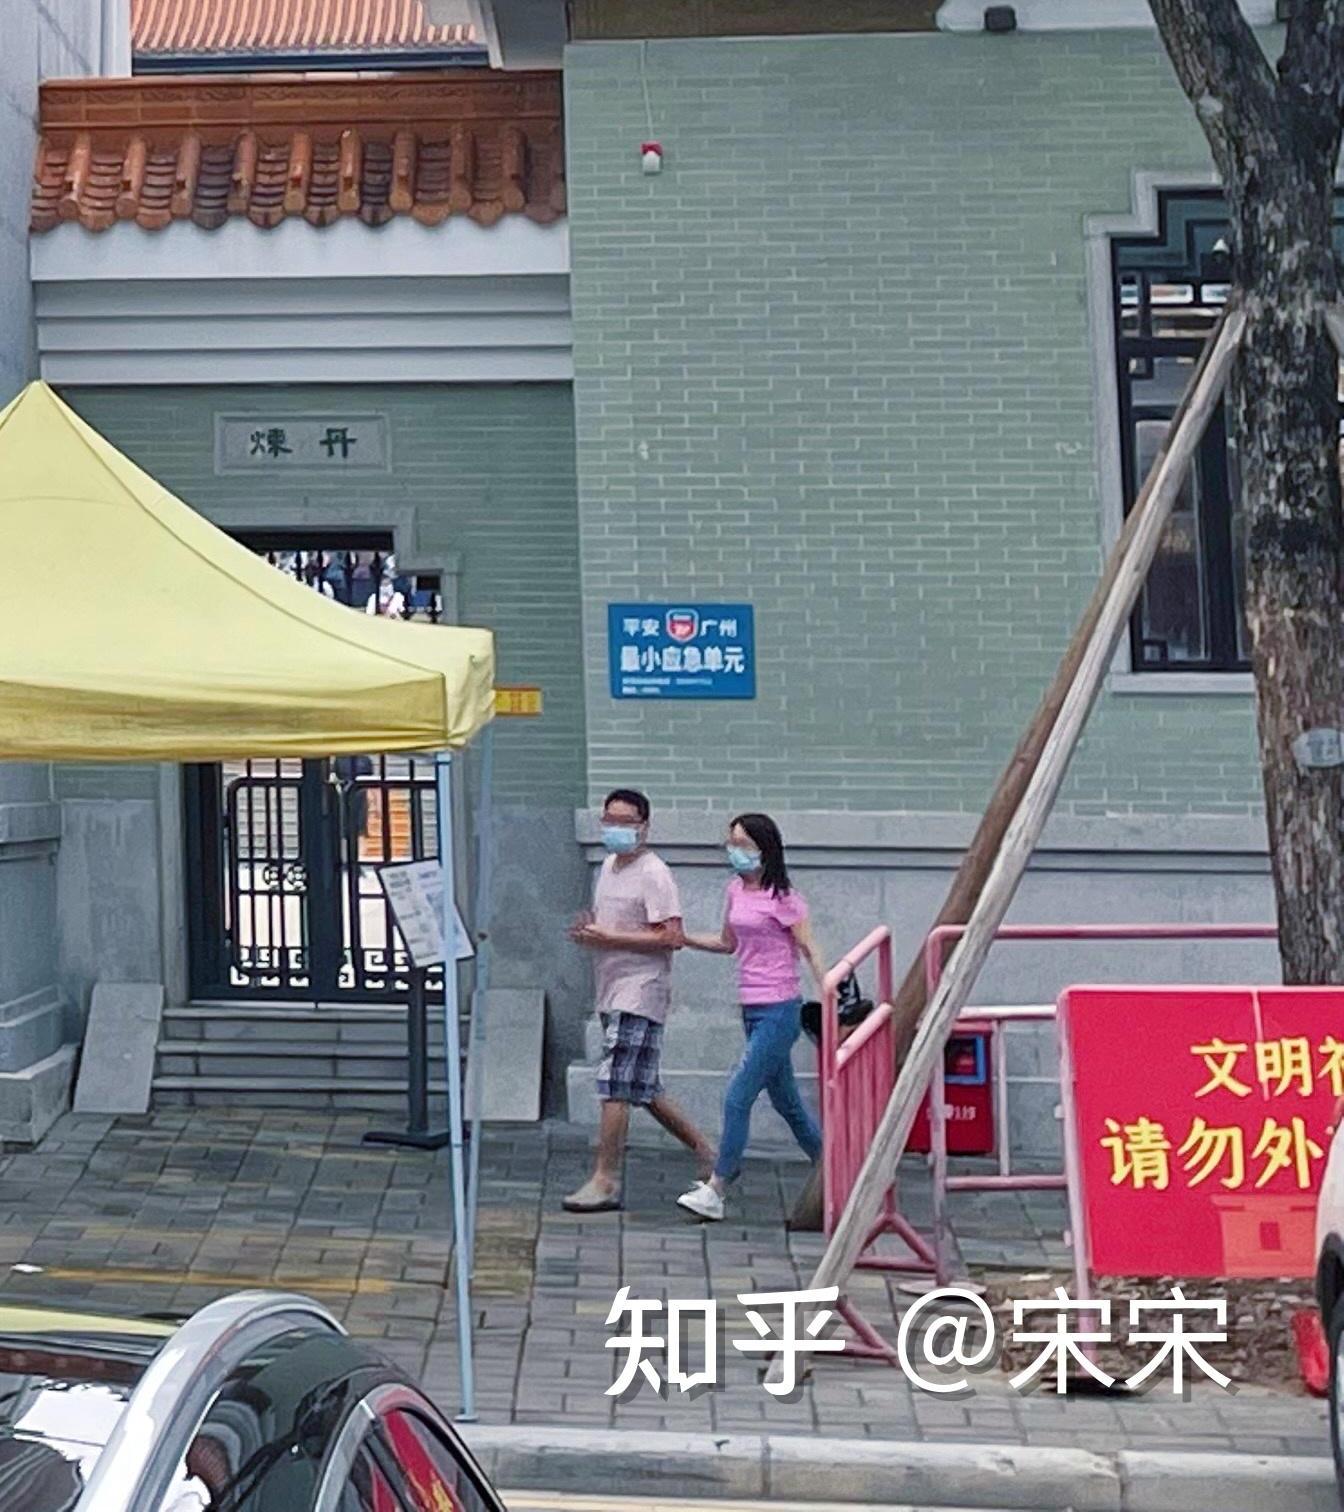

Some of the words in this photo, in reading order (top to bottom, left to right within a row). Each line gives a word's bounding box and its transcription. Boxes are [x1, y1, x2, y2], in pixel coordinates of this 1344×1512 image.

[622, 618, 660, 637] 平安
[700, 618, 738, 637] 广州
[620, 645, 745, 673] 最小应急单元
